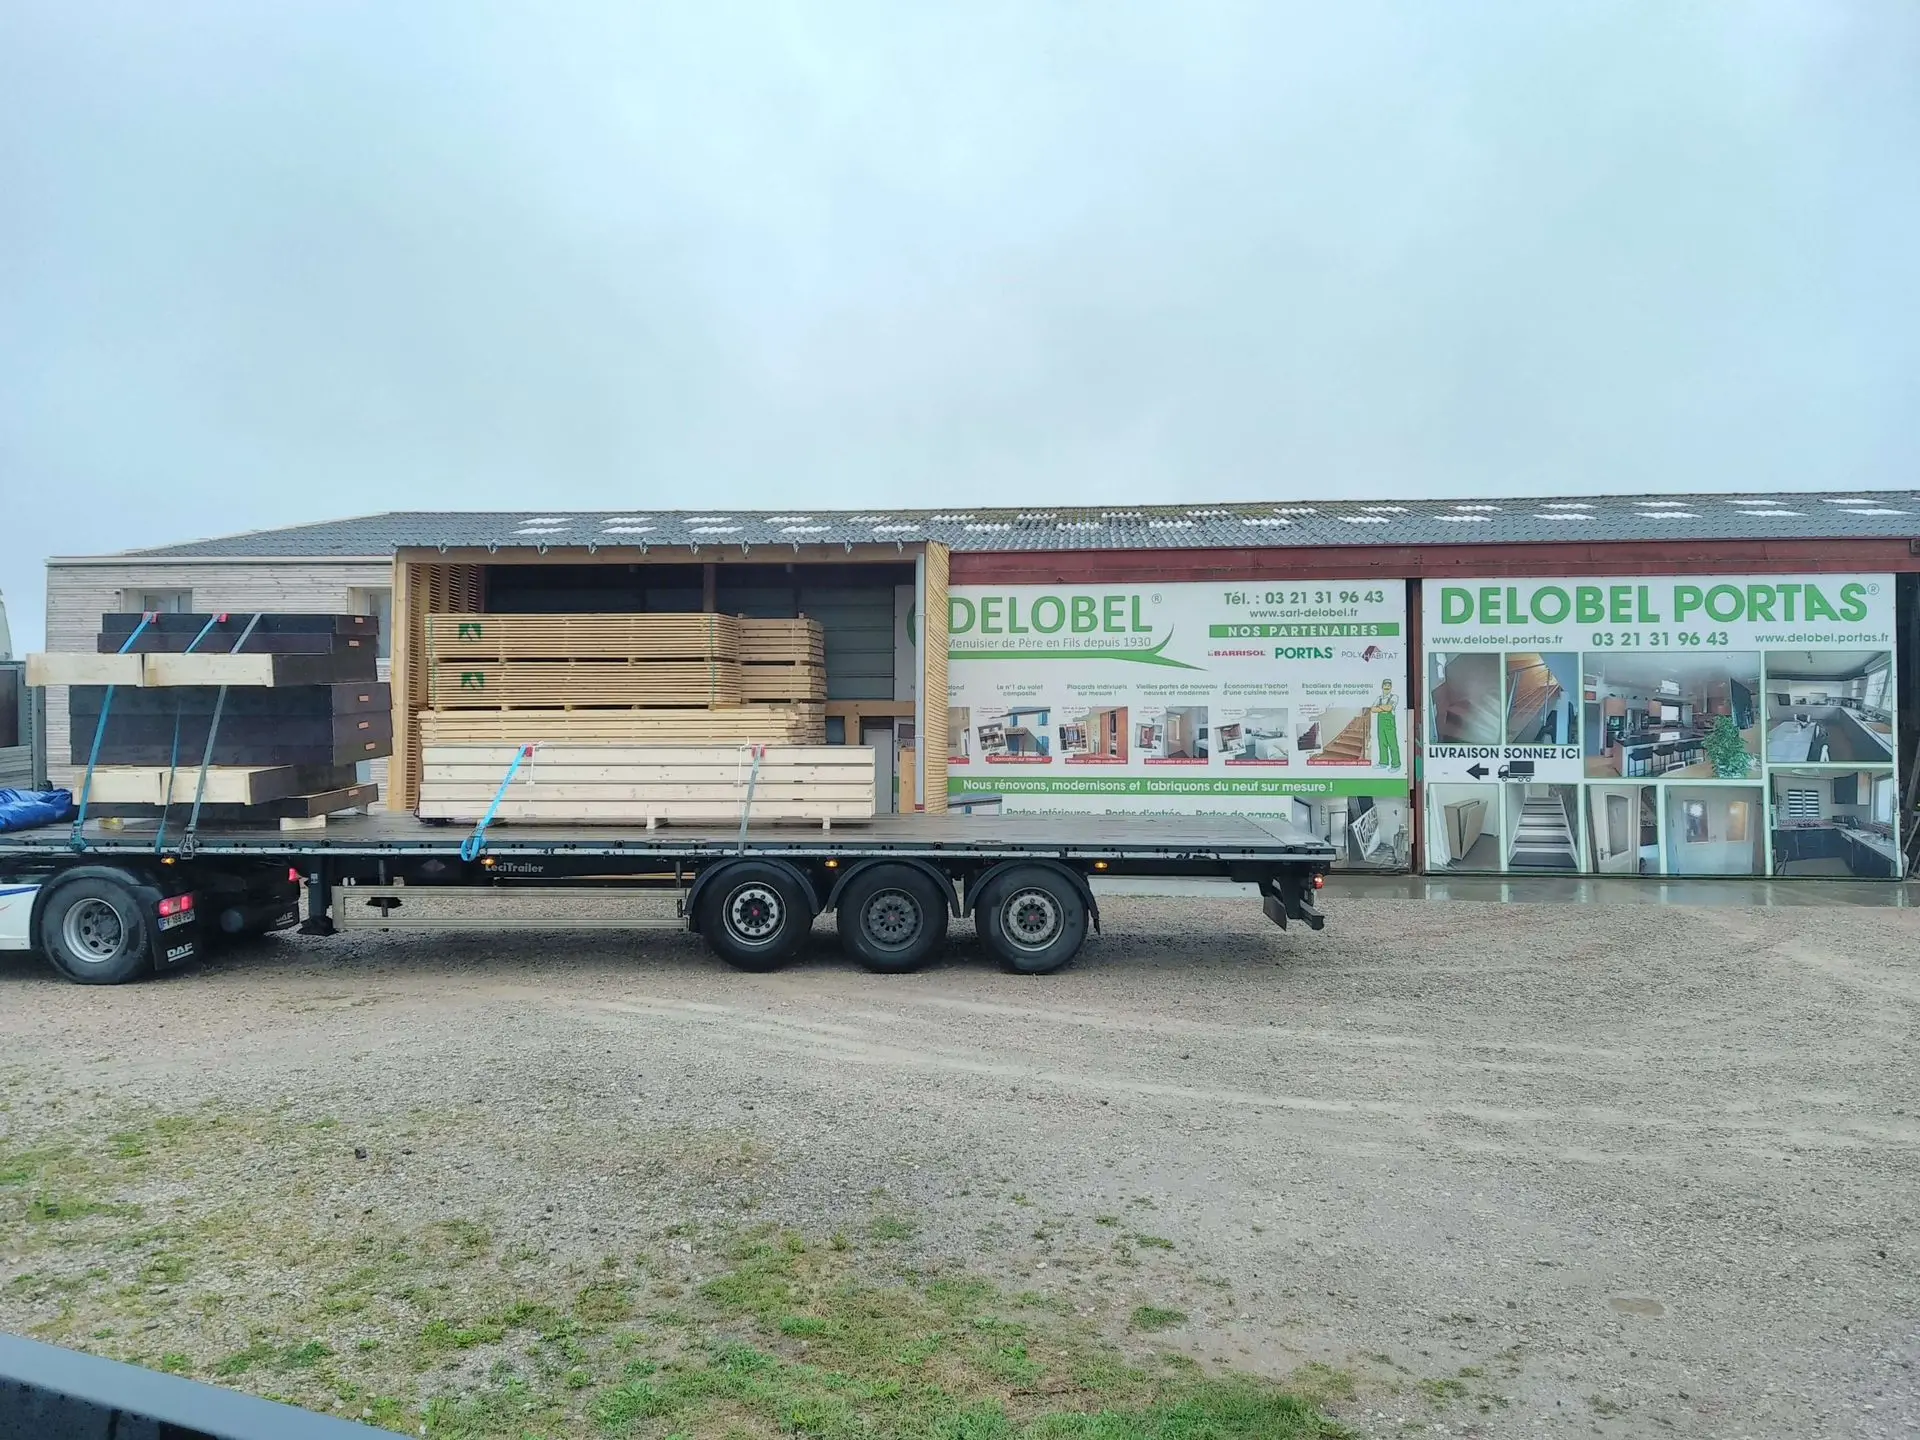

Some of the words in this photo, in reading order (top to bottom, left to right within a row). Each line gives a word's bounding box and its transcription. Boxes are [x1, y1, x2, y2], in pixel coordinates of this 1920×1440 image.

[1224, 592, 1250, 605] Tél.
[1265, 592, 1284, 604] 03
[1290, 592, 1306, 604] 21
[1315, 592, 1331, 604] 31
[1339, 591, 1359, 604] 96
[1364, 591, 1384, 603] 43
[1441, 586, 1660, 624] DELOBEL
[1674, 583, 1867, 622] PORTAS
[948, 595, 1152, 634] DELOBEL
[1250, 608, 1358, 618] www.sarl-delobel.fr
[1228, 626, 1261, 636] NOS
[1269, 625, 1378, 636] PARTENAIRES
[1002, 637, 1015, 648] de
[1019, 637, 1043, 648] Père
[1046, 639, 1059, 648] en
[1063, 636, 1080, 648] Fils
[1084, 636, 1120, 649] depuis
[1124, 637, 1151, 647] 1930
[1432, 634, 1563, 646] www.delobel.portas.fr
[1592, 632, 1614, 646] 03
[1620, 632, 1640, 646] 21
[1650, 632, 1668, 646] 31
[1678, 632, 1700, 646] 96
[1706, 632, 1728, 645] 43
[1755, 633, 1888, 644] www.delobel.portas.fr
[1275, 647, 1332, 659] PORTAS
[1429, 748, 1499, 758] LIVRAISON
[1504, 748, 1556, 759] SONNEZ
[1561, 748, 1580, 759] ICI
[964, 780, 991, 790] Nous
[995, 779, 1049, 792] rénovons,
[1052, 780, 1125, 791] modernisons
[1129, 781, 1140, 791] et
[1147, 781, 1210, 793] fabriquons
[1214, 781, 1228, 791] du
[1232, 781, 1258, 791] neuf
[1261, 783, 1278, 791] sur
[1282, 784, 1326, 792] mesure
[166, 943, 193, 958] DAF
